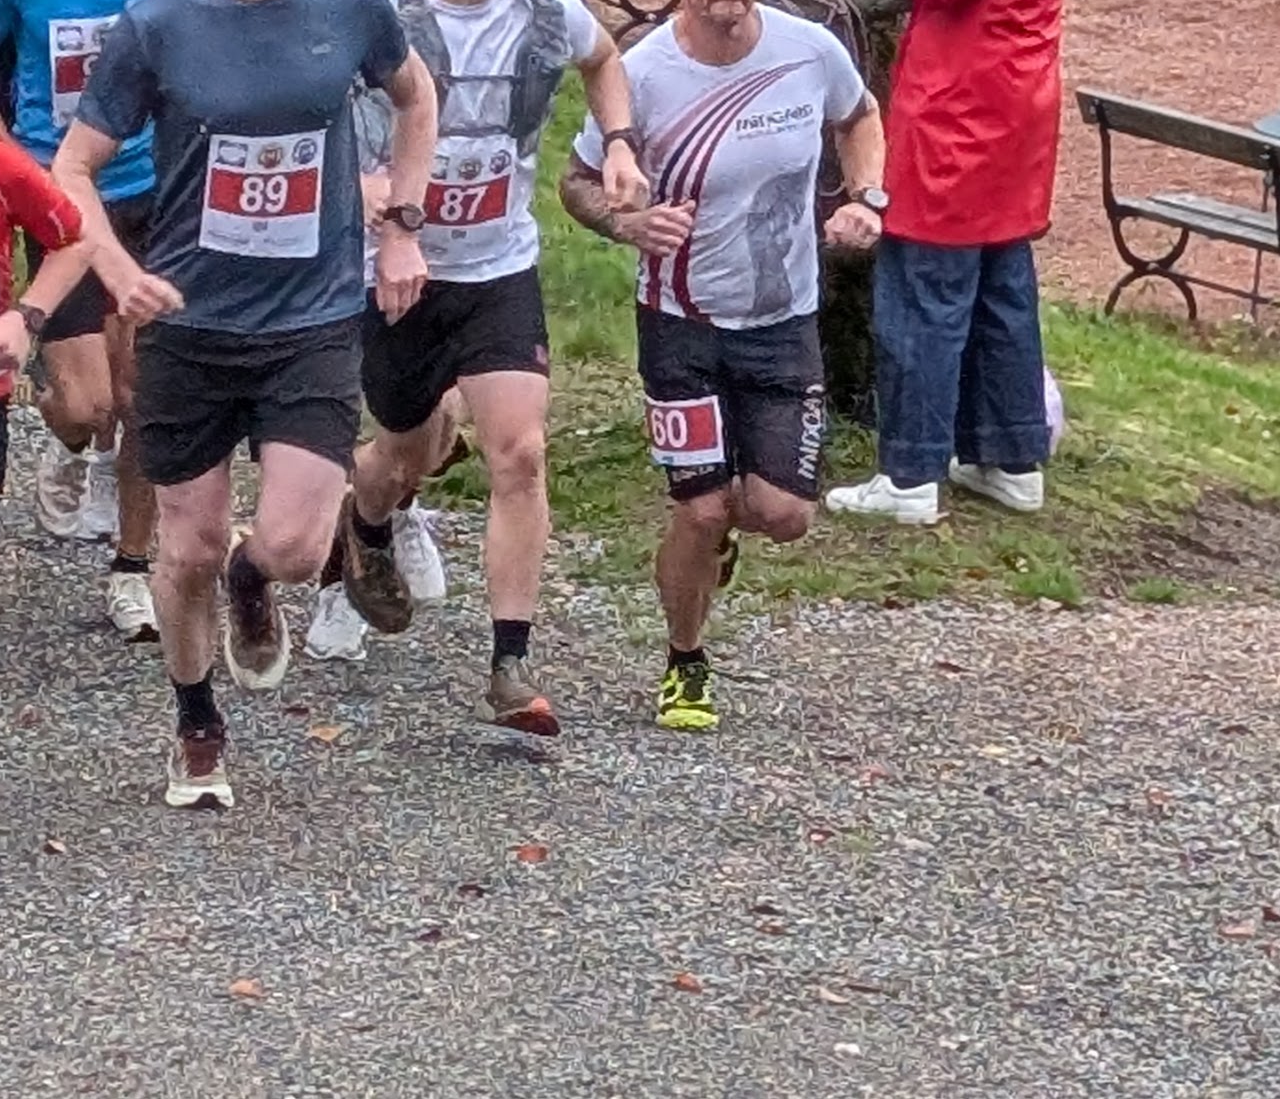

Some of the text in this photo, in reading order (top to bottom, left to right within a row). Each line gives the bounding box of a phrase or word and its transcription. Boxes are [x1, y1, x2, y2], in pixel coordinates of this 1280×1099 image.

[239, 175, 288, 213] 89
[440, 185, 489, 221] 87
[650, 408, 688, 448] 60
